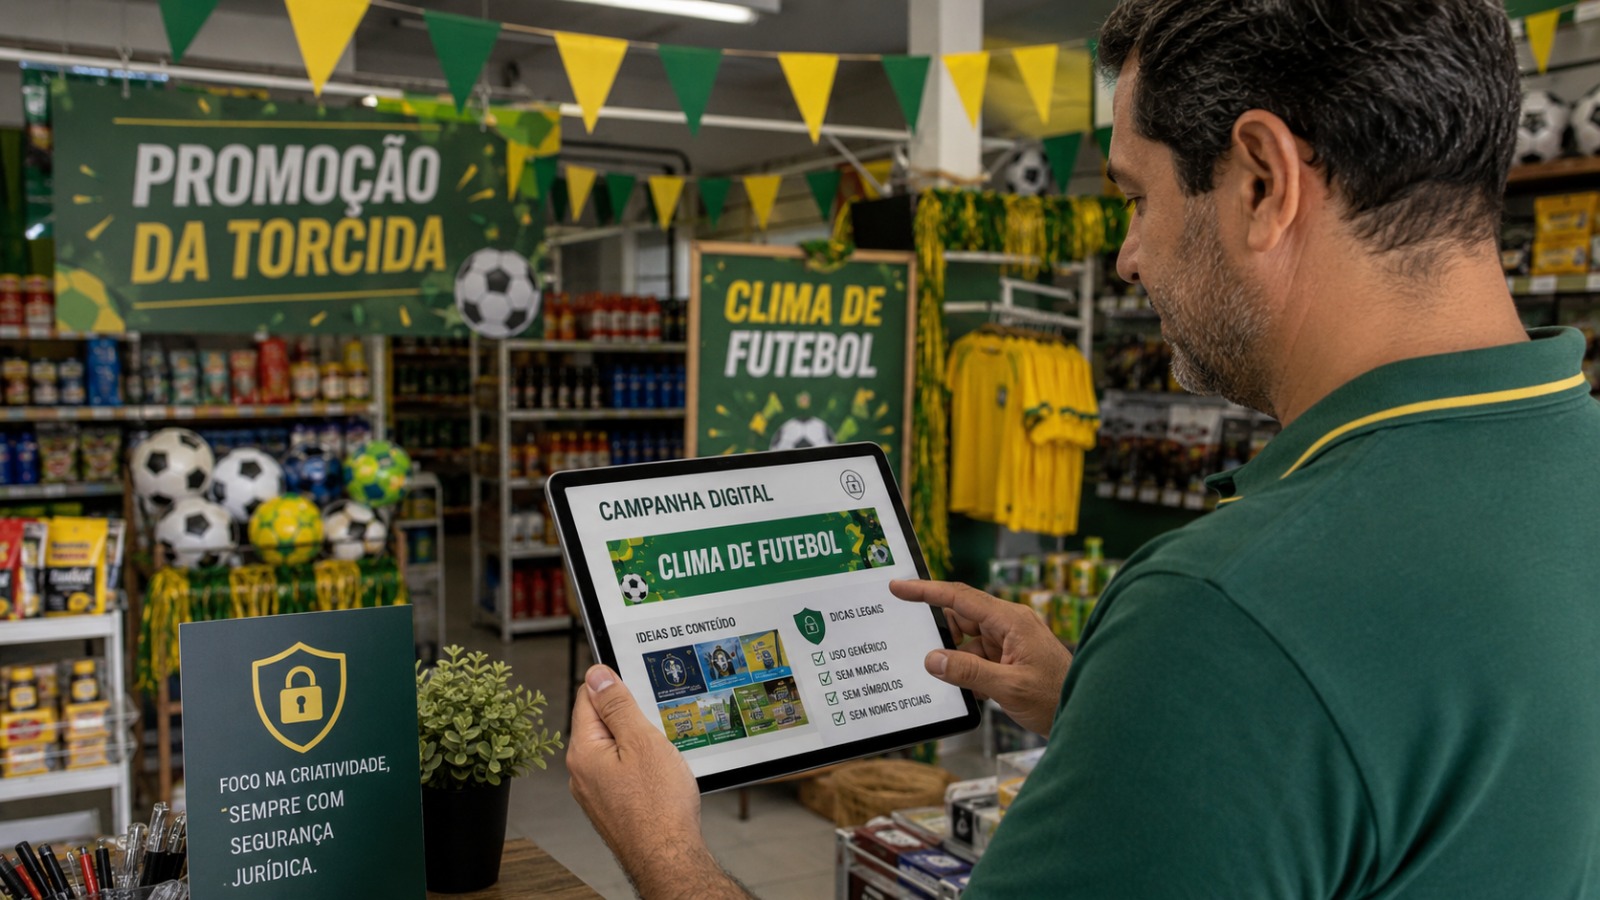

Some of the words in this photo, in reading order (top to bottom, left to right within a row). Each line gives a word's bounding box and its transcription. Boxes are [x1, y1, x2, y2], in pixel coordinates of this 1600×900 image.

[132, 135, 441, 218] PROMOÇÃO
[131, 221, 209, 285] DA
[226, 215, 447, 279] TORCIDA
[724, 279, 832, 326] CLIMA
[840, 284, 886, 327] DE
[724, 330, 877, 378] FUTEBOL
[599, 491, 706, 521] CAMPANHA
[708, 484, 774, 508] DIGITAL
[657, 546, 725, 581] CLIMA
[727, 541, 756, 570] DE
[757, 530, 842, 565] FUTEBOL
[636, 628, 669, 643] IDEIAS
[670, 625, 684, 637] DE
[685, 616, 736, 635] CONTEÚDO
[829, 609, 855, 622] DICAS
[856, 604, 884, 617] LEGAIS
[829, 648, 847, 661] USO
[848, 641, 888, 656] GENÉRICO
[835, 669, 855, 681] SEM
[855, 661, 890, 676] MARCAS
[842, 688, 861, 701] SEM
[861, 679, 904, 696] SÍMBOLOS
[849, 709, 868, 721] SEM
[868, 701, 898, 716] NOMES
[898, 694, 932, 710] OFICIAIS
[220, 773, 260, 794] FOCO
[265, 769, 286, 787] NA
[290, 756, 391, 783] CRIATIVIDADE,
[229, 796, 301, 823] SEMPRE
[306, 789, 344, 812] COM
[230, 822, 334, 855] SEGURANÇA
[231, 857, 317, 887] JURÍDICA.
